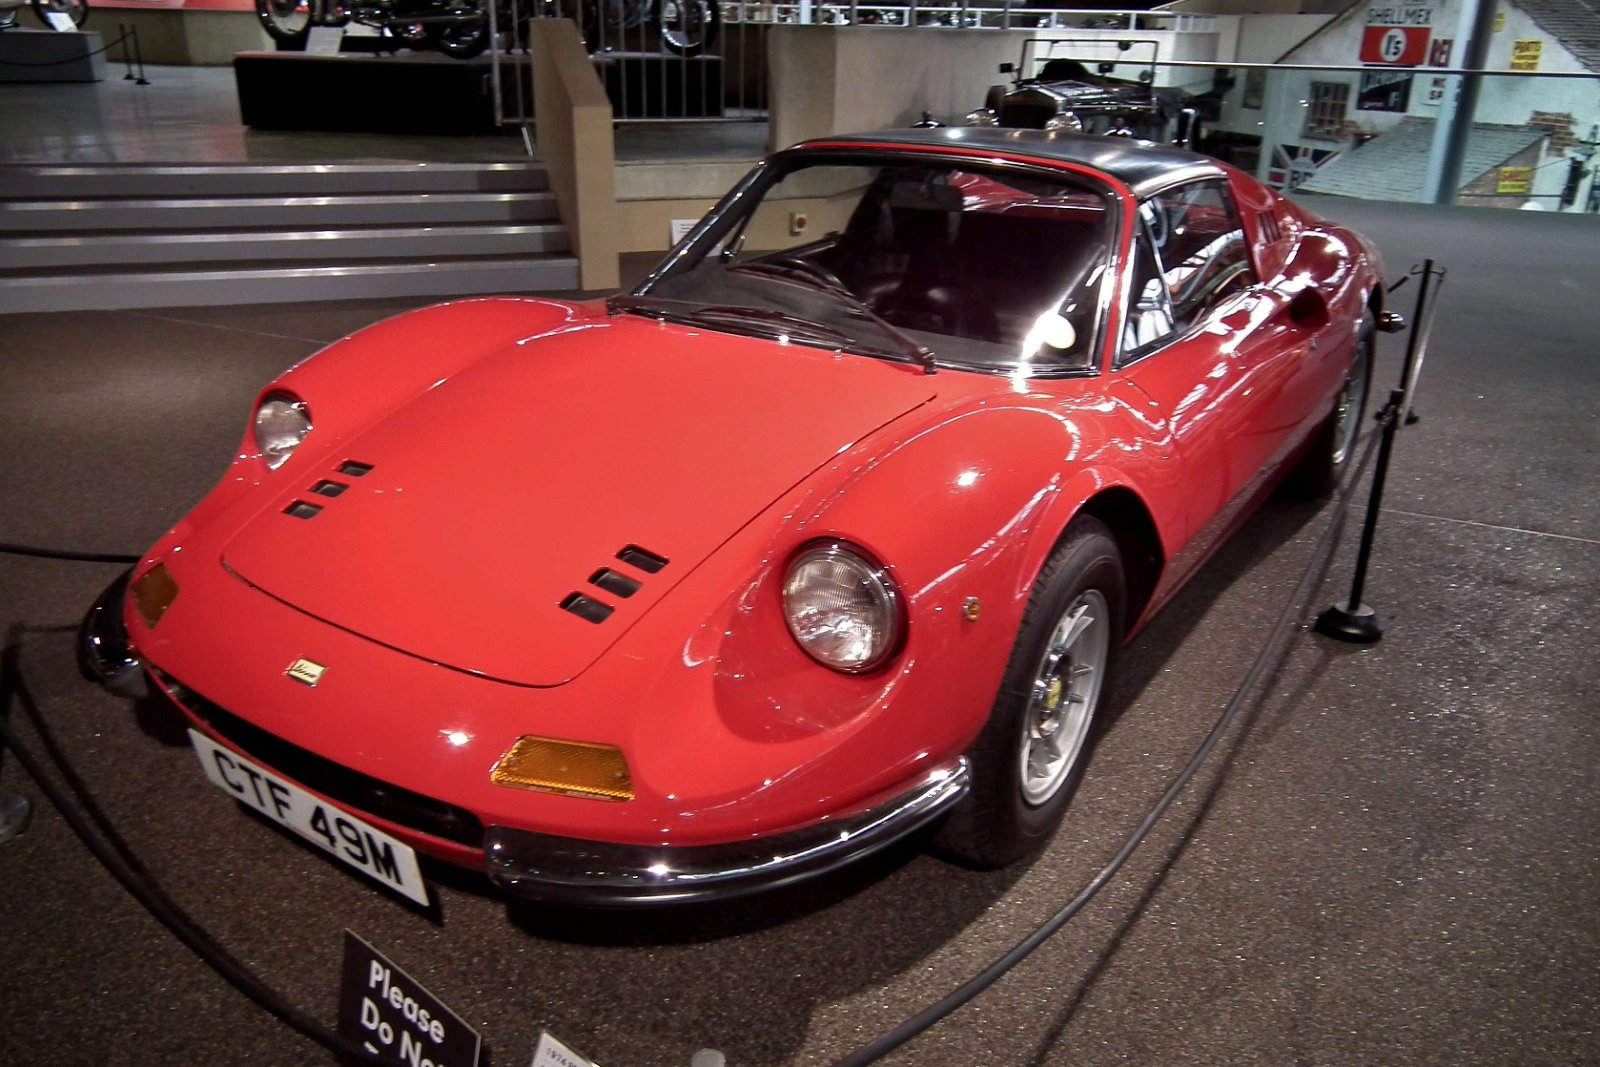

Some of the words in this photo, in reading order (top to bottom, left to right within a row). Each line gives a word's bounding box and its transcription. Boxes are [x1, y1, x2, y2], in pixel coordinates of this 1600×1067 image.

[212, 748, 291, 820] CTF
[310, 805, 404, 886] 49M
[360, 996, 394, 1046] Do
[368, 959, 446, 1044] Please
